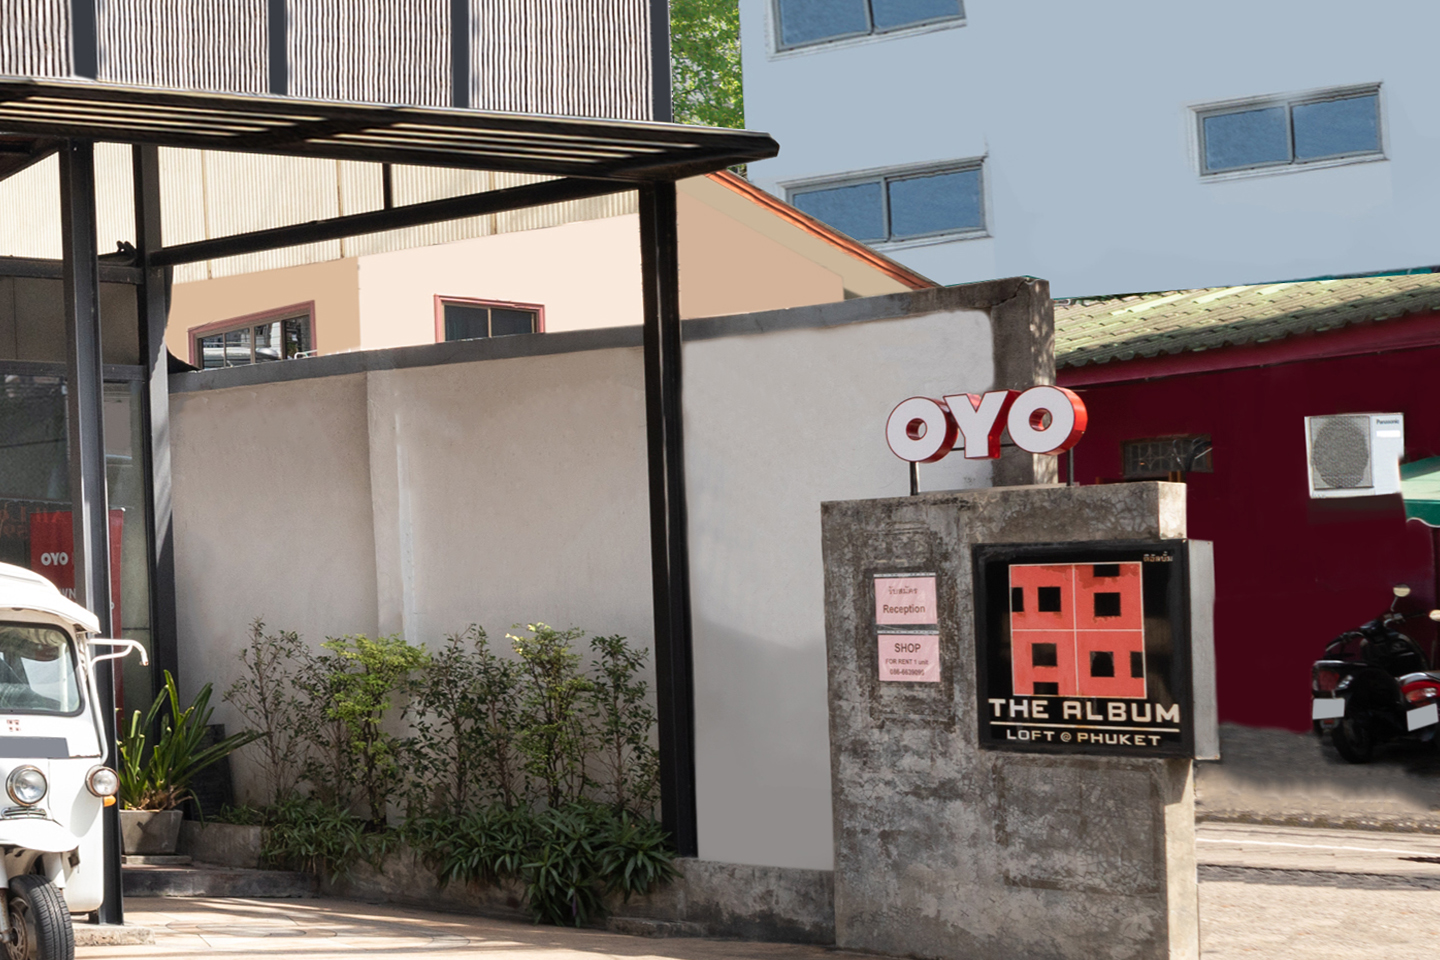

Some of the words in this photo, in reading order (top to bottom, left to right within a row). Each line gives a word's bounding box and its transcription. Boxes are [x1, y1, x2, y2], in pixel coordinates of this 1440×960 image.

[885, 385, 1087, 463] OYO
[41, 552, 68, 566] OYO
[882, 604, 926, 615] Reception
[894, 643, 921, 653] SHOP
[988, 698, 1049, 719] THE
[1063, 700, 1180, 724] ALBUM
[1006, 729, 1055, 741] LOFT
[1060, 731, 1072, 742] @
[1076, 732, 1161, 746] PHUKET
